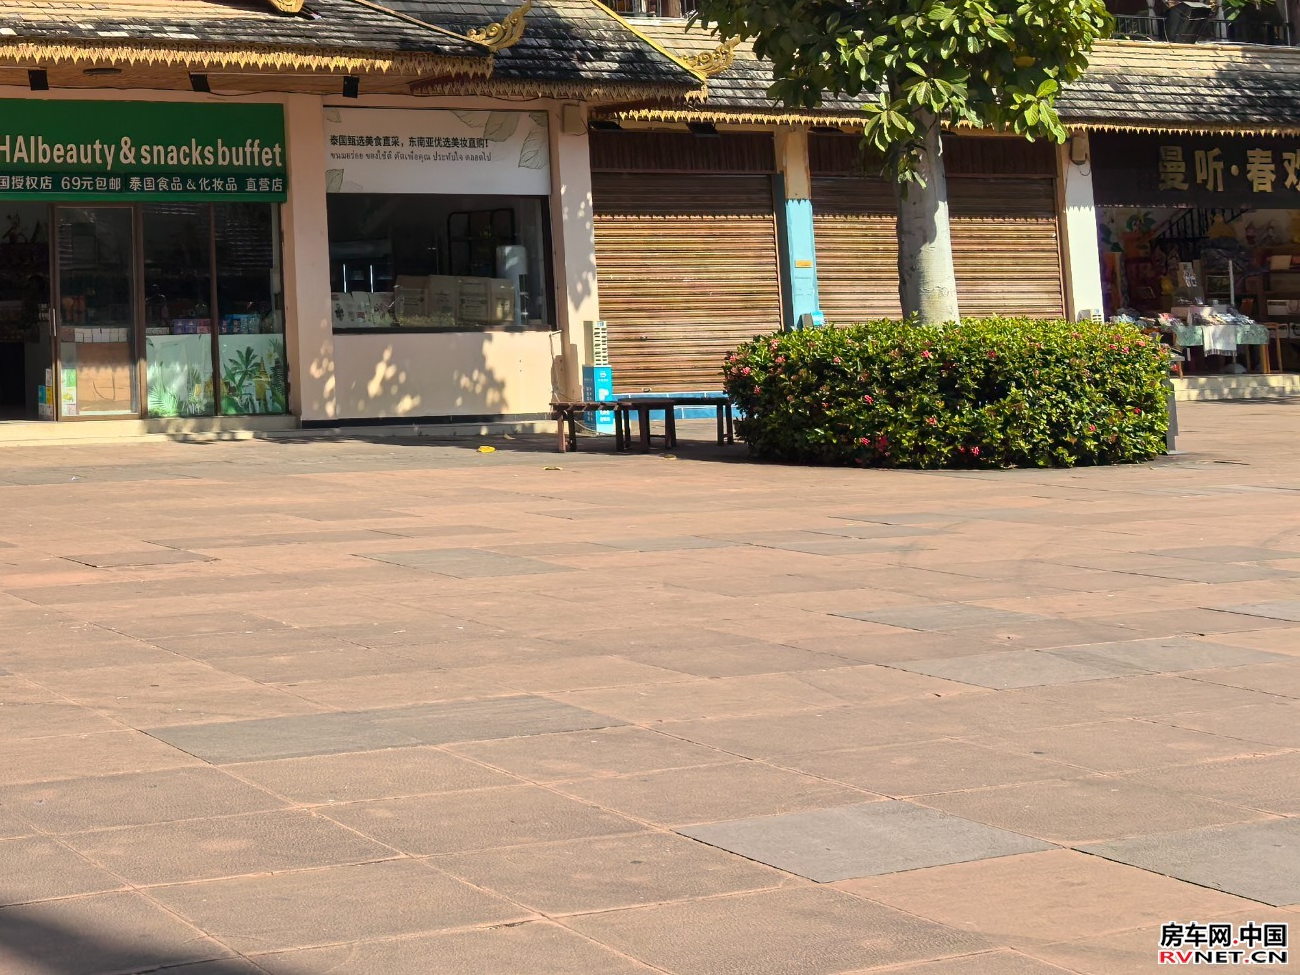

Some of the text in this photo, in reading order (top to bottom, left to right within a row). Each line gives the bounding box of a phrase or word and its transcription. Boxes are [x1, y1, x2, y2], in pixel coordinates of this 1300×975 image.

[119, 136, 136, 165] &
[61, 176, 121, 191] 69元包邮
[245, 177, 283, 192] 直营店
